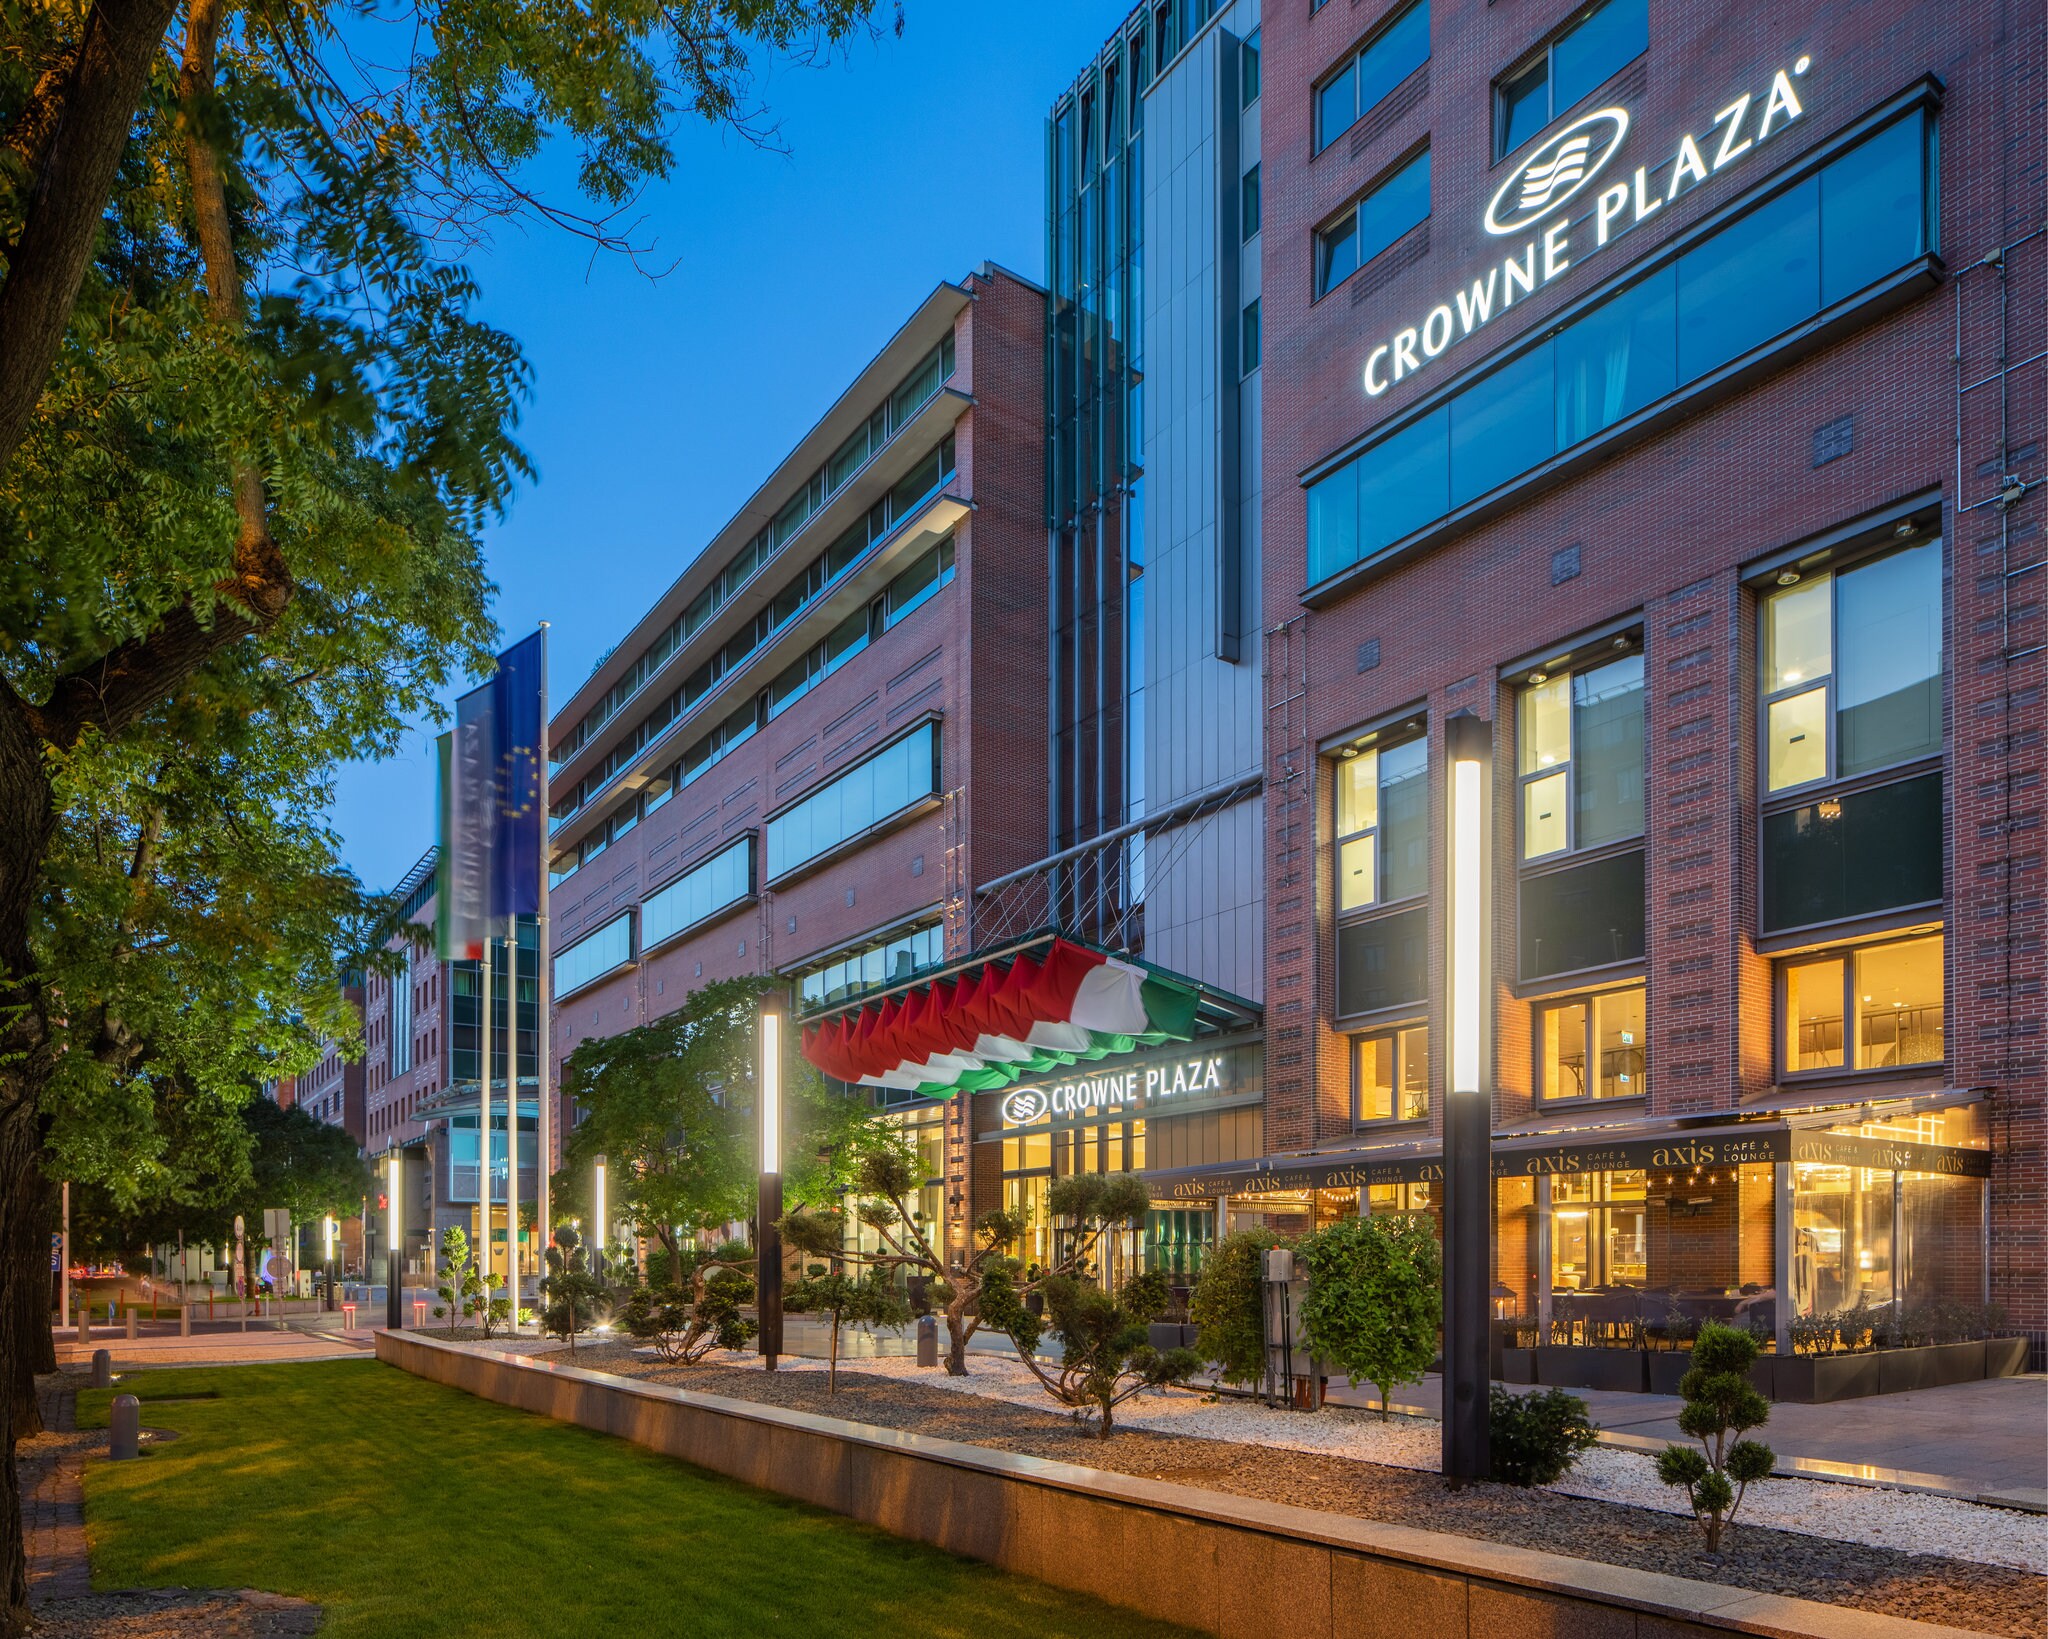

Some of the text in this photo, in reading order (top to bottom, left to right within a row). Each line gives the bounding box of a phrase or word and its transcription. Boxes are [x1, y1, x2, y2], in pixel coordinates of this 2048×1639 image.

[1363, 70, 1803, 396] CROWNE PLAZA
[1052, 1059, 1220, 1113] CROWNE PLAZA
[1587, 1151, 1626, 1160] CAFÉ &
[1652, 1139, 1715, 1166] axis
[1723, 1141, 1770, 1152] CAFÉ &
[1799, 1142, 1832, 1161] axis
[1872, 1143, 1903, 1166] axis
[1526, 1149, 1579, 1173] axis
[1587, 1161, 1630, 1170] LOUNGE
[1723, 1152, 1775, 1162] LOUNGE
[1937, 1150, 1964, 1174] axis
[1245, 1172, 1280, 1192] axis
[1327, 1165, 1367, 1187] axis
[1371, 1175, 1404, 1184] LOUNGE
[1420, 1164, 1443, 1181] ax
[1174, 1178, 1205, 1198] axis
[1208, 1187, 1233, 1195] LOUNGE
[1284, 1182, 1313, 1190] LOUNGE
